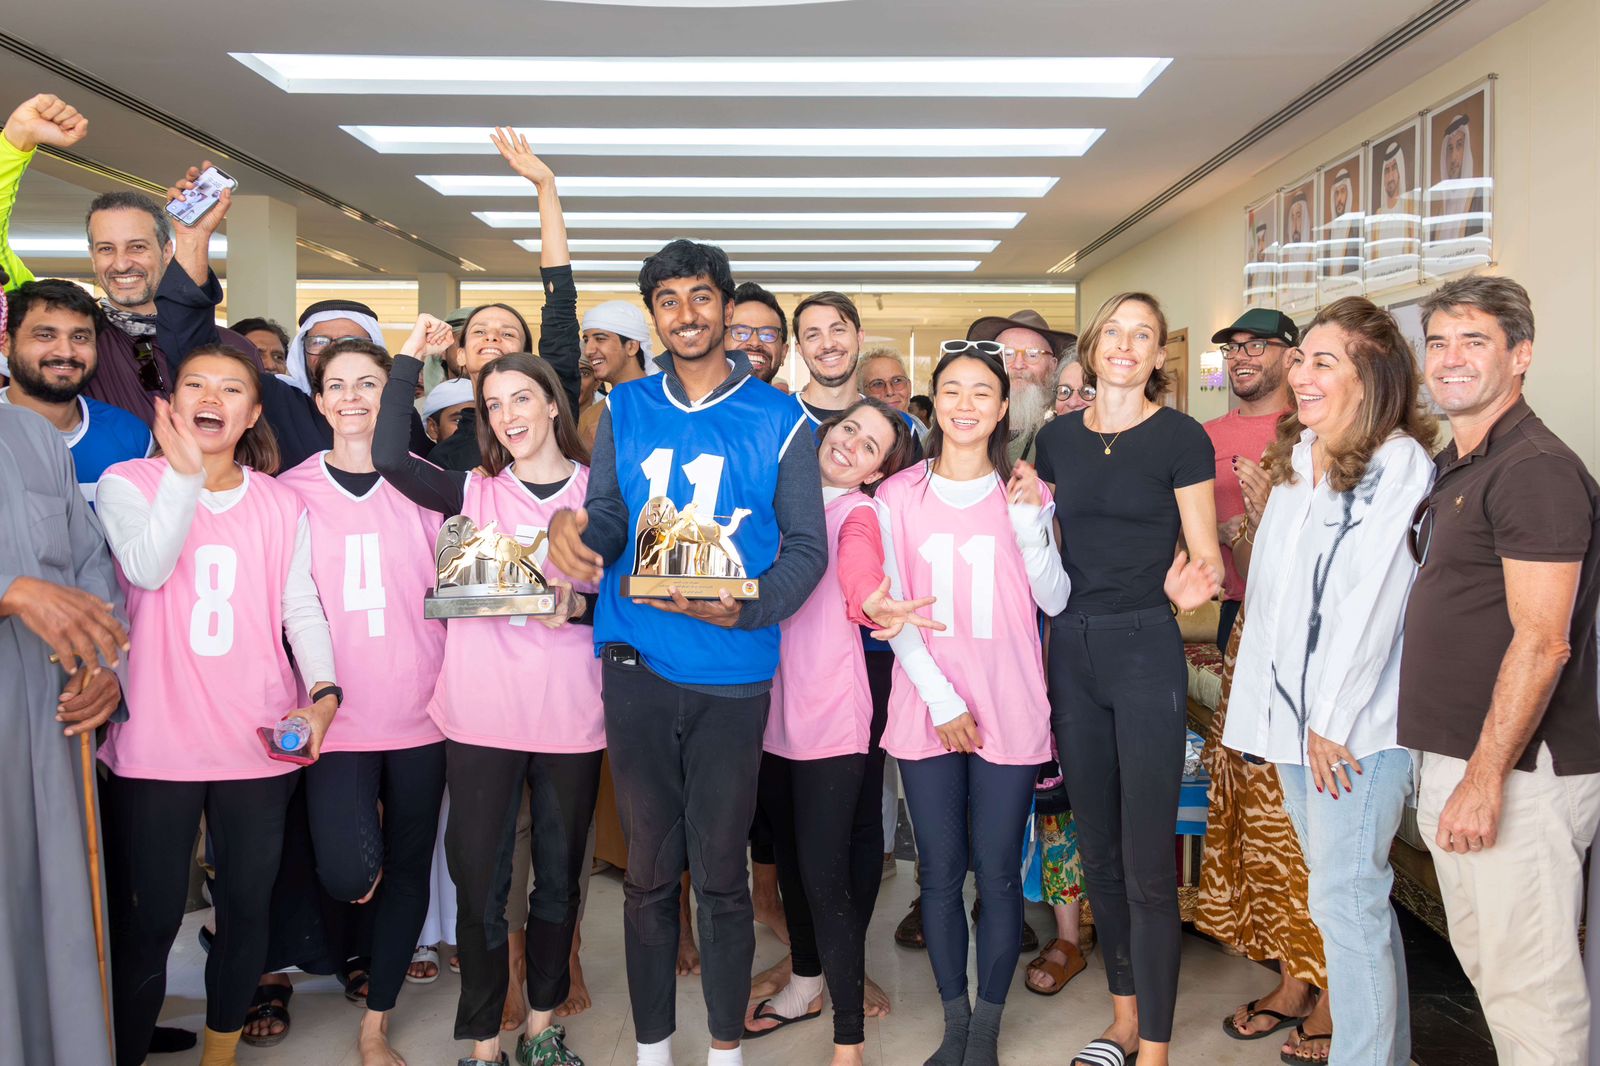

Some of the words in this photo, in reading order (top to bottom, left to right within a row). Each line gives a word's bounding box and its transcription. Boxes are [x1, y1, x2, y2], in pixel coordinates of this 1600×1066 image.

[640, 448, 725, 525] 11
[189, 543, 238, 657] 8
[343, 532, 387, 638] 4
[917, 532, 996, 640] 11
